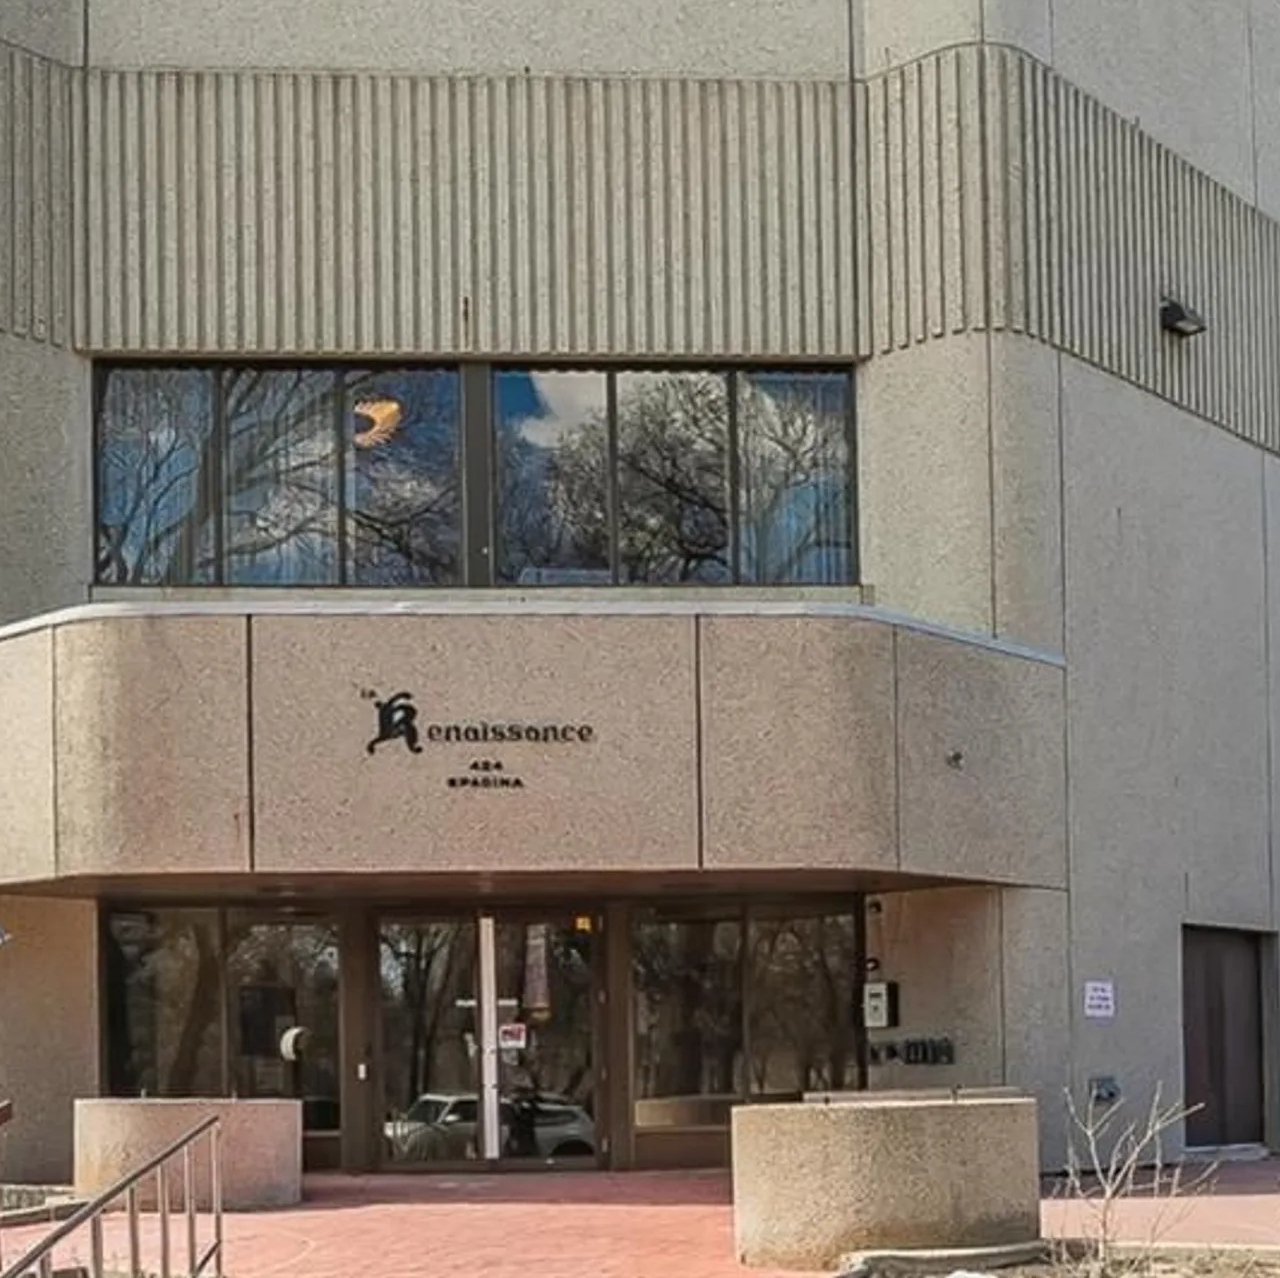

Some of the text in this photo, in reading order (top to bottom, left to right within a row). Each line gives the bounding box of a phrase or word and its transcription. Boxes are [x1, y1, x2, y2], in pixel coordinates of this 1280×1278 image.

[367, 692, 593, 754] Renaissance
[469, 760, 503, 771] 424
[447, 777, 524, 788] SPADINA
